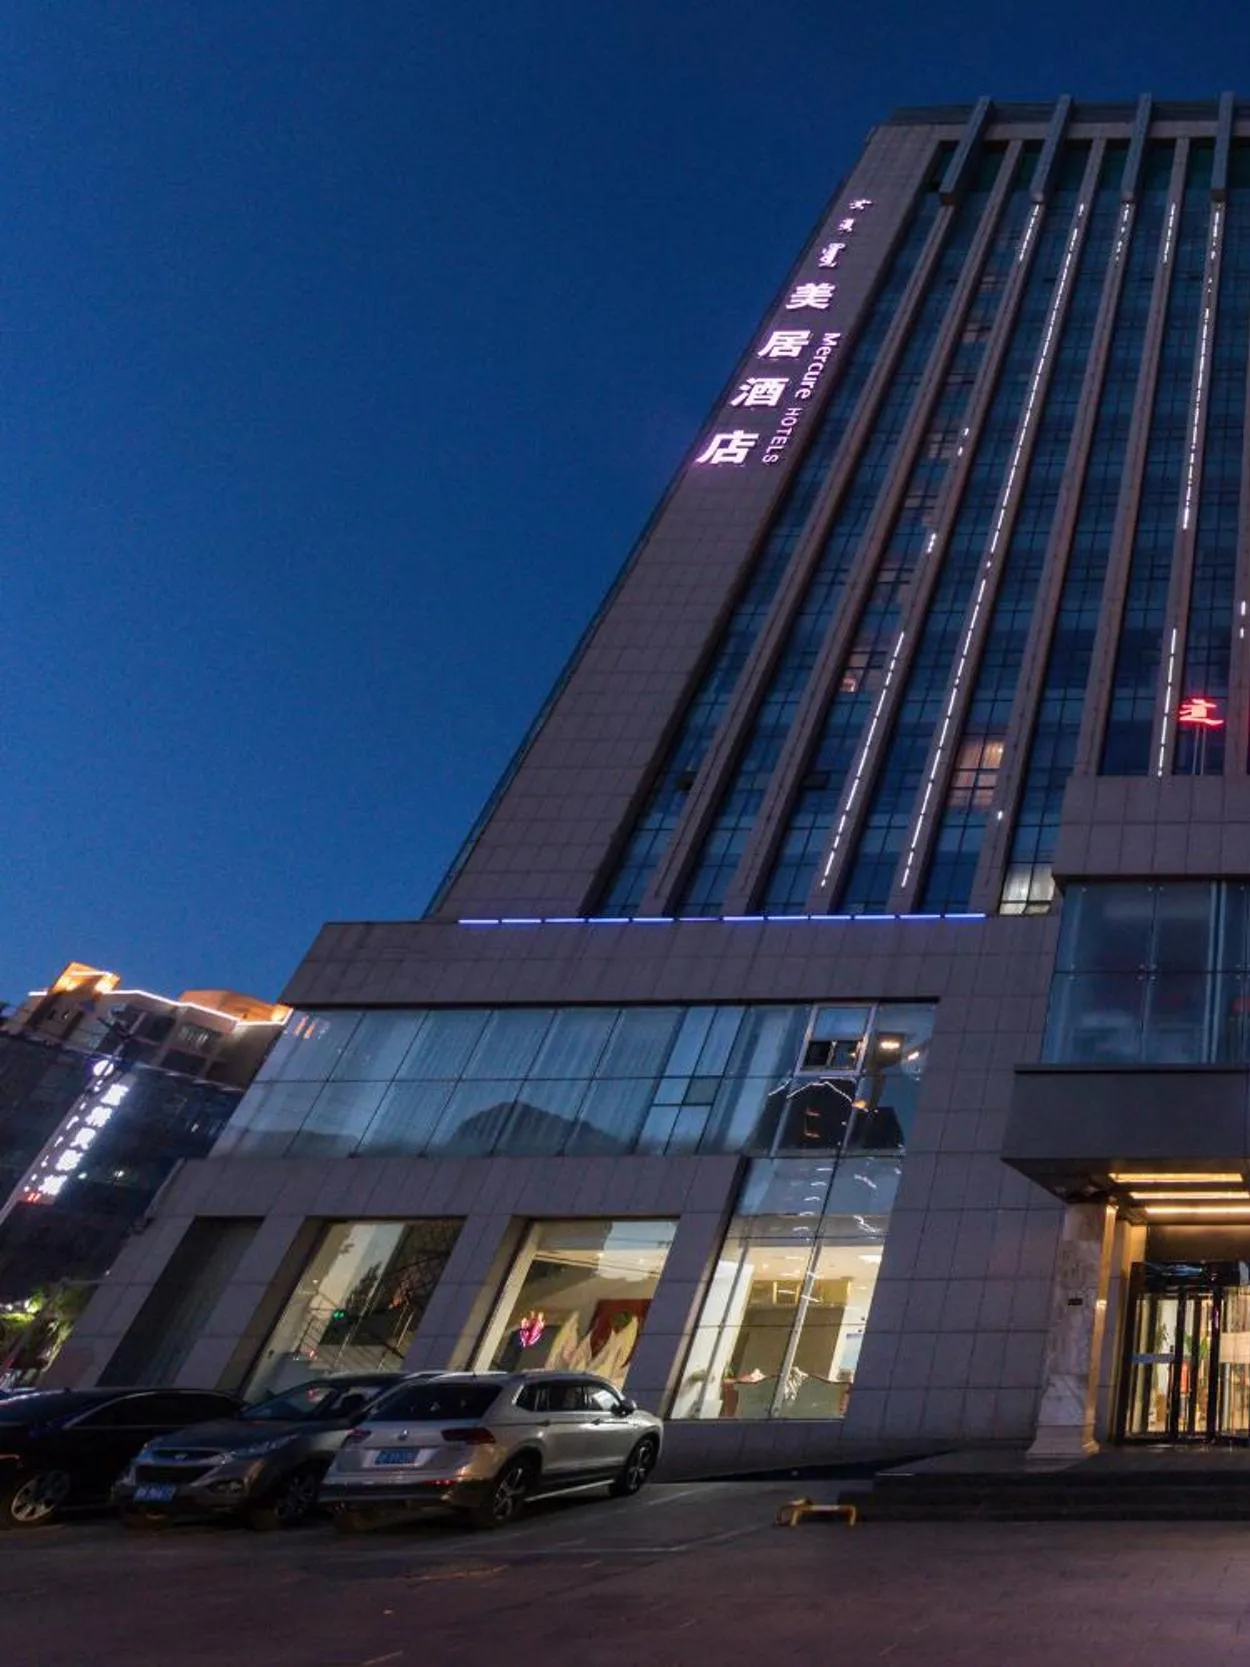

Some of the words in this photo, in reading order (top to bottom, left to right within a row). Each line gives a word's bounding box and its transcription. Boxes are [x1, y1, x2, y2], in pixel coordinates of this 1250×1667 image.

[696, 282, 836, 465] 美居酒店
[794, 332, 842, 400] Mercure
[761, 407, 803, 464] HOTELS
